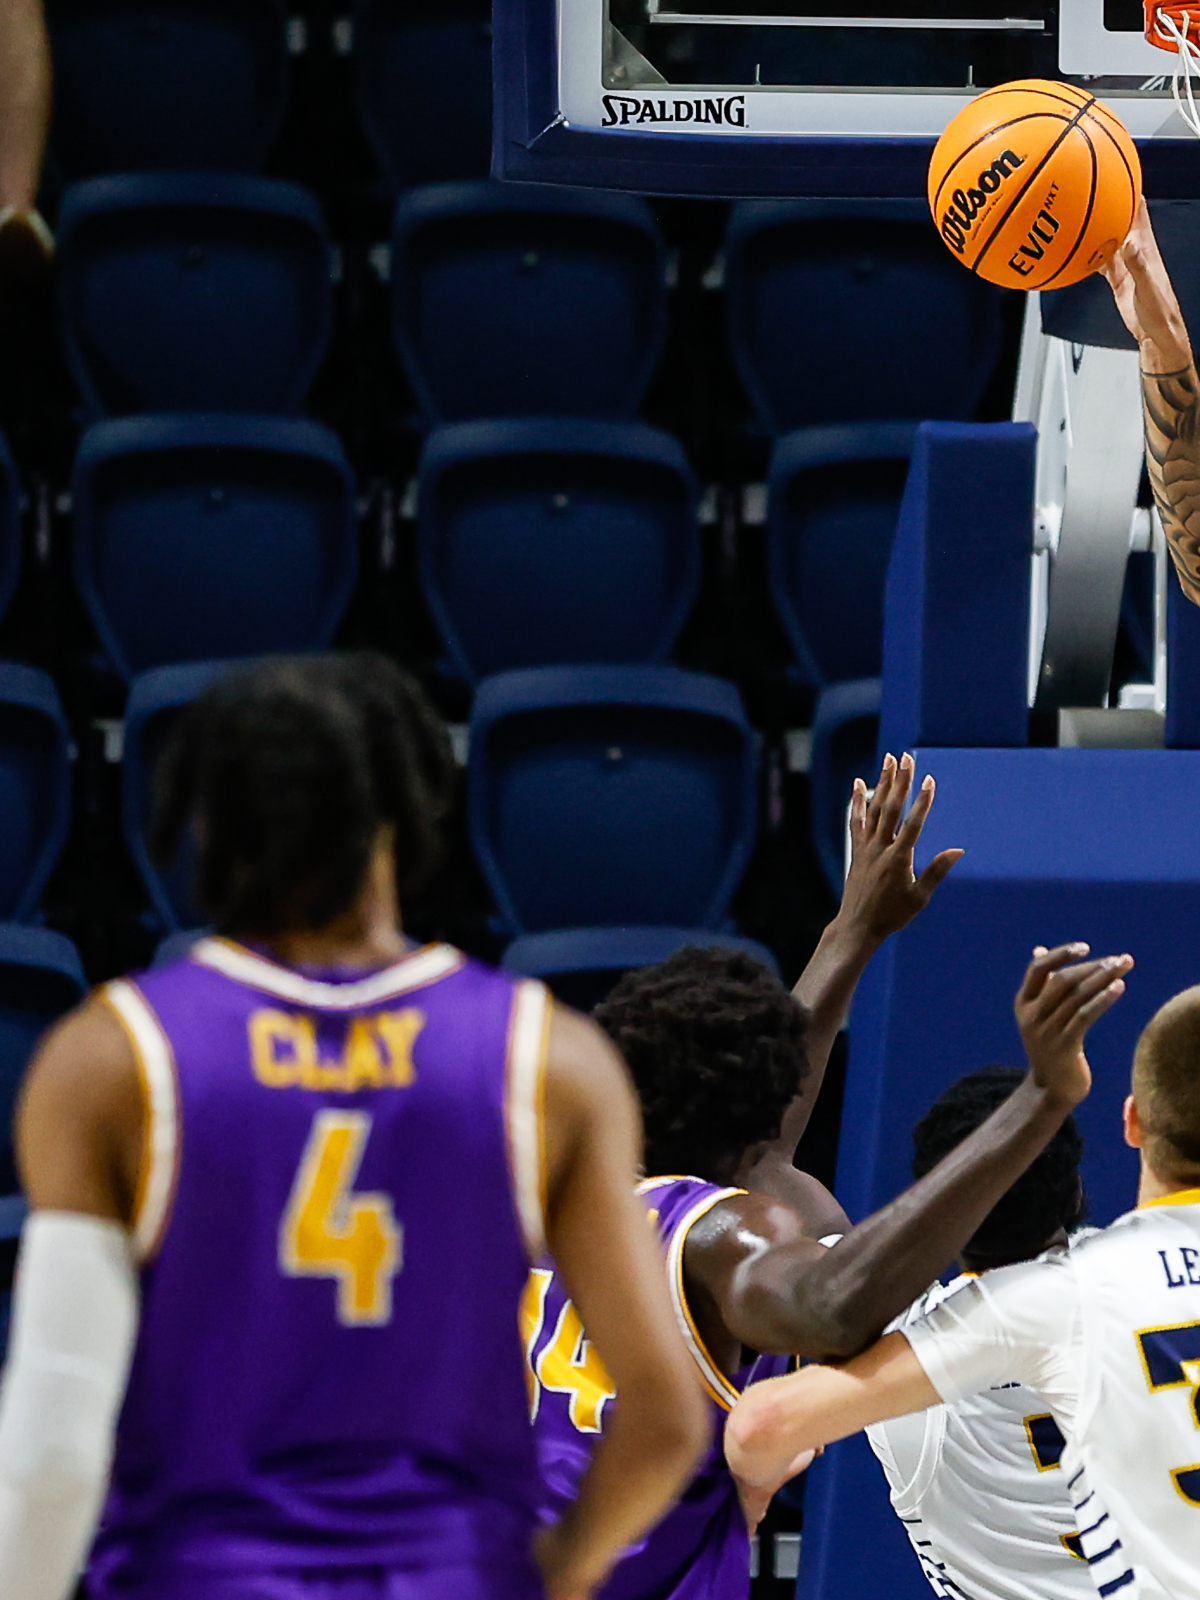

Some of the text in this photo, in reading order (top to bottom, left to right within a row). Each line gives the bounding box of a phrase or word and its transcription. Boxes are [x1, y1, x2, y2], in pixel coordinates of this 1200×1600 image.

[602, 94, 745, 128] SPALDING
[942, 149, 1024, 254] Wilson
[1008, 180, 1060, 276] EVO NXT
[247, 1006, 428, 1093] CLAY
[278, 1107, 404, 1328] 4
